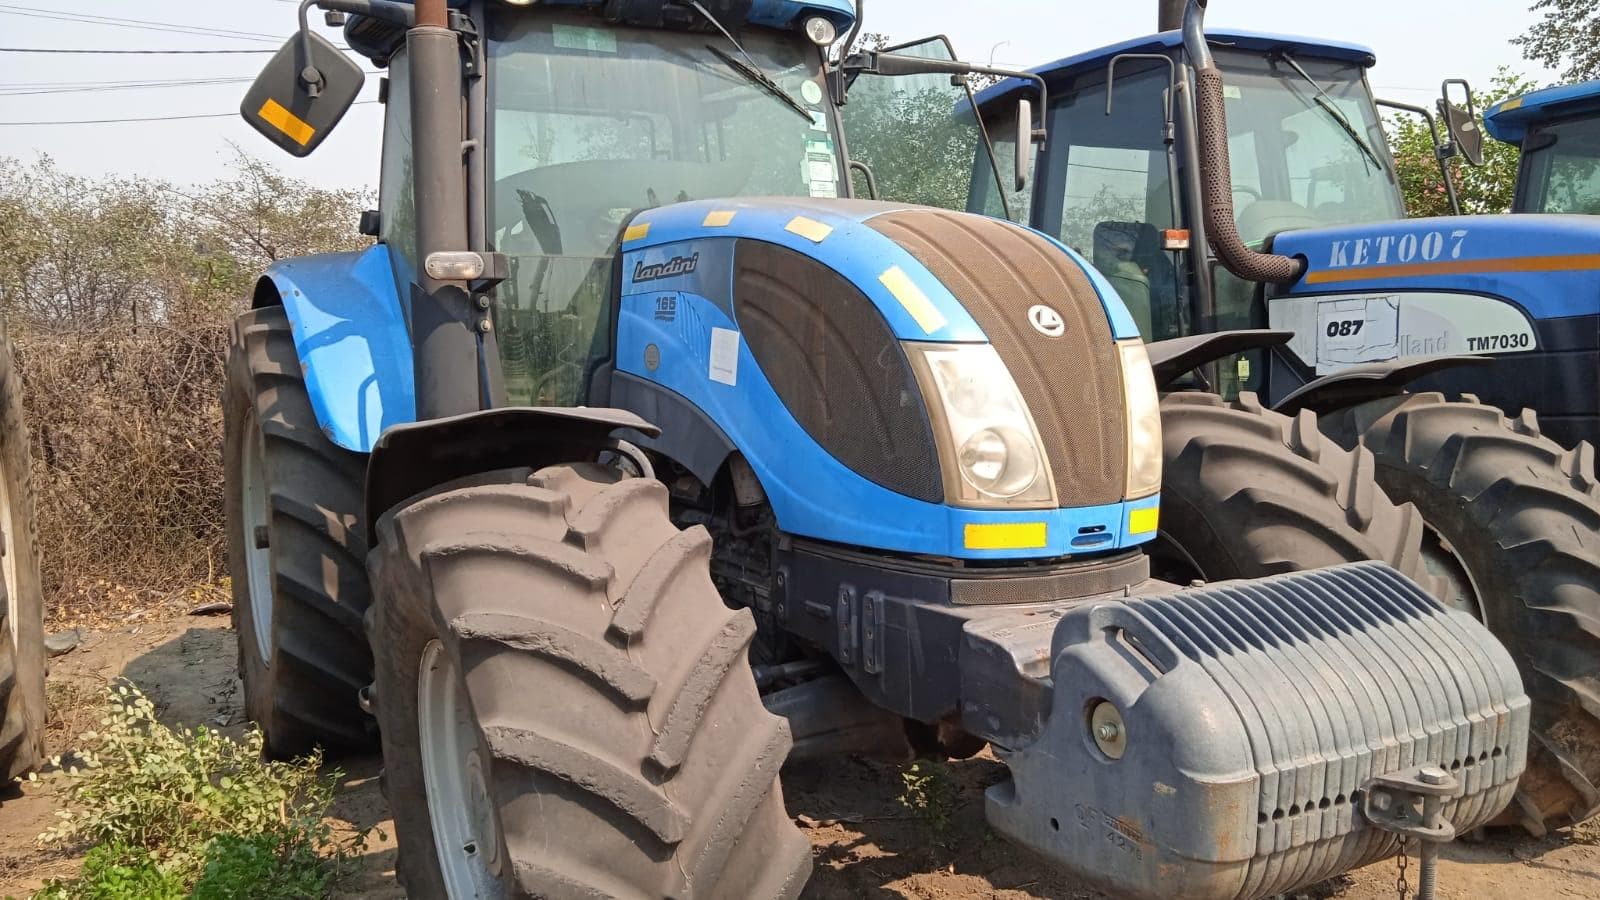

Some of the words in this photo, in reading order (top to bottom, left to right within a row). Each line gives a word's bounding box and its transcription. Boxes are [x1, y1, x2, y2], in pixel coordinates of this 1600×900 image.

[632, 253, 698, 283] Landini
[656, 296, 676, 310] 165
[1327, 320, 1364, 337] 087
[1400, 328, 1448, 357] lland
[1467, 333, 1529, 351] TM7030
